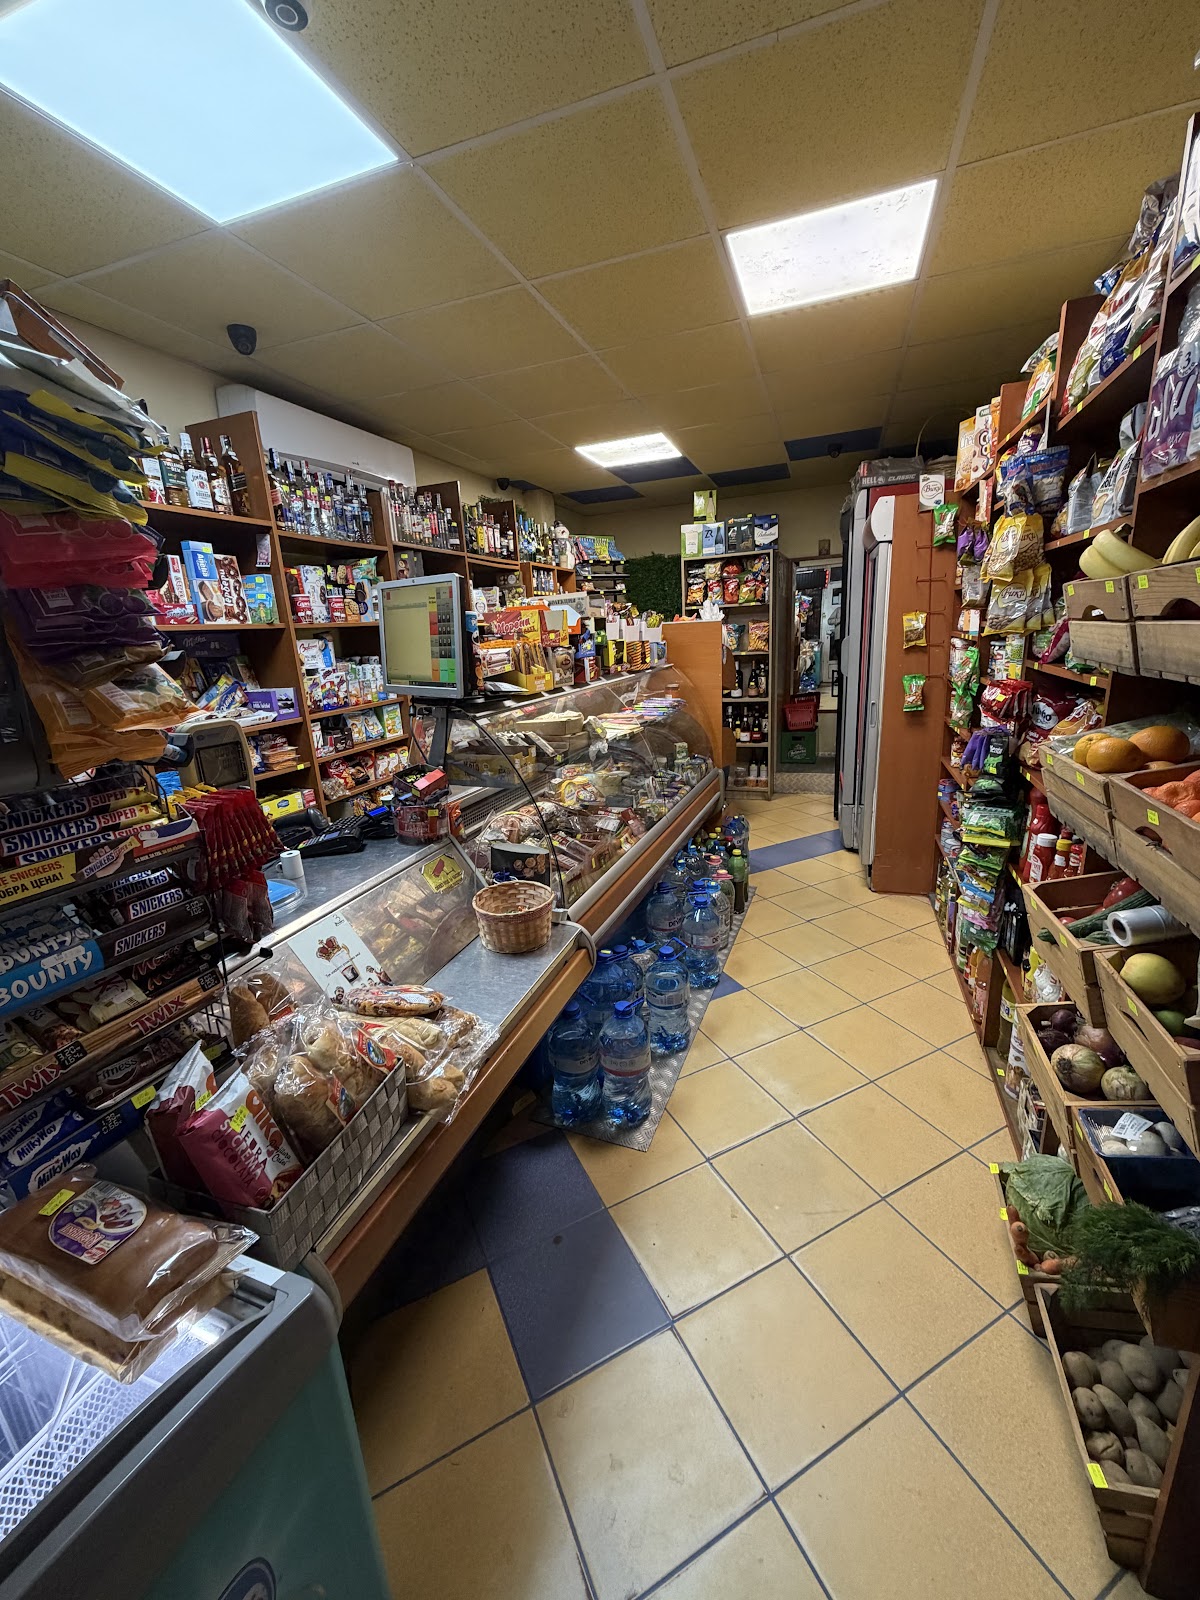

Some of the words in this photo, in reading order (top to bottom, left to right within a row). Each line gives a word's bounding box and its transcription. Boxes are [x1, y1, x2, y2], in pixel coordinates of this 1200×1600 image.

[862, 476, 877, 486] HELL
[887, 473, 917, 482] CLASSIC
[219, 568, 234, 608] Гербери
[0, 797, 88, 833] SNICKERS
[90, 788, 128, 807] SUPER
[3, 816, 98, 852] SNICKERS
[102, 807, 137, 826] SUPER
[139, 803, 151, 815] +1
[12, 861, 65, 884] SNICKERS.
[83, 851, 116, 877] SNICKERS
[30, 871, 65, 893] ЦЕНА!
[114, 871, 169, 900] SNICKERS
[132, 888, 183, 918] SNICKERS
[0, 931, 73, 975] OUNTY
[115, 922, 167, 955] SNICKERS
